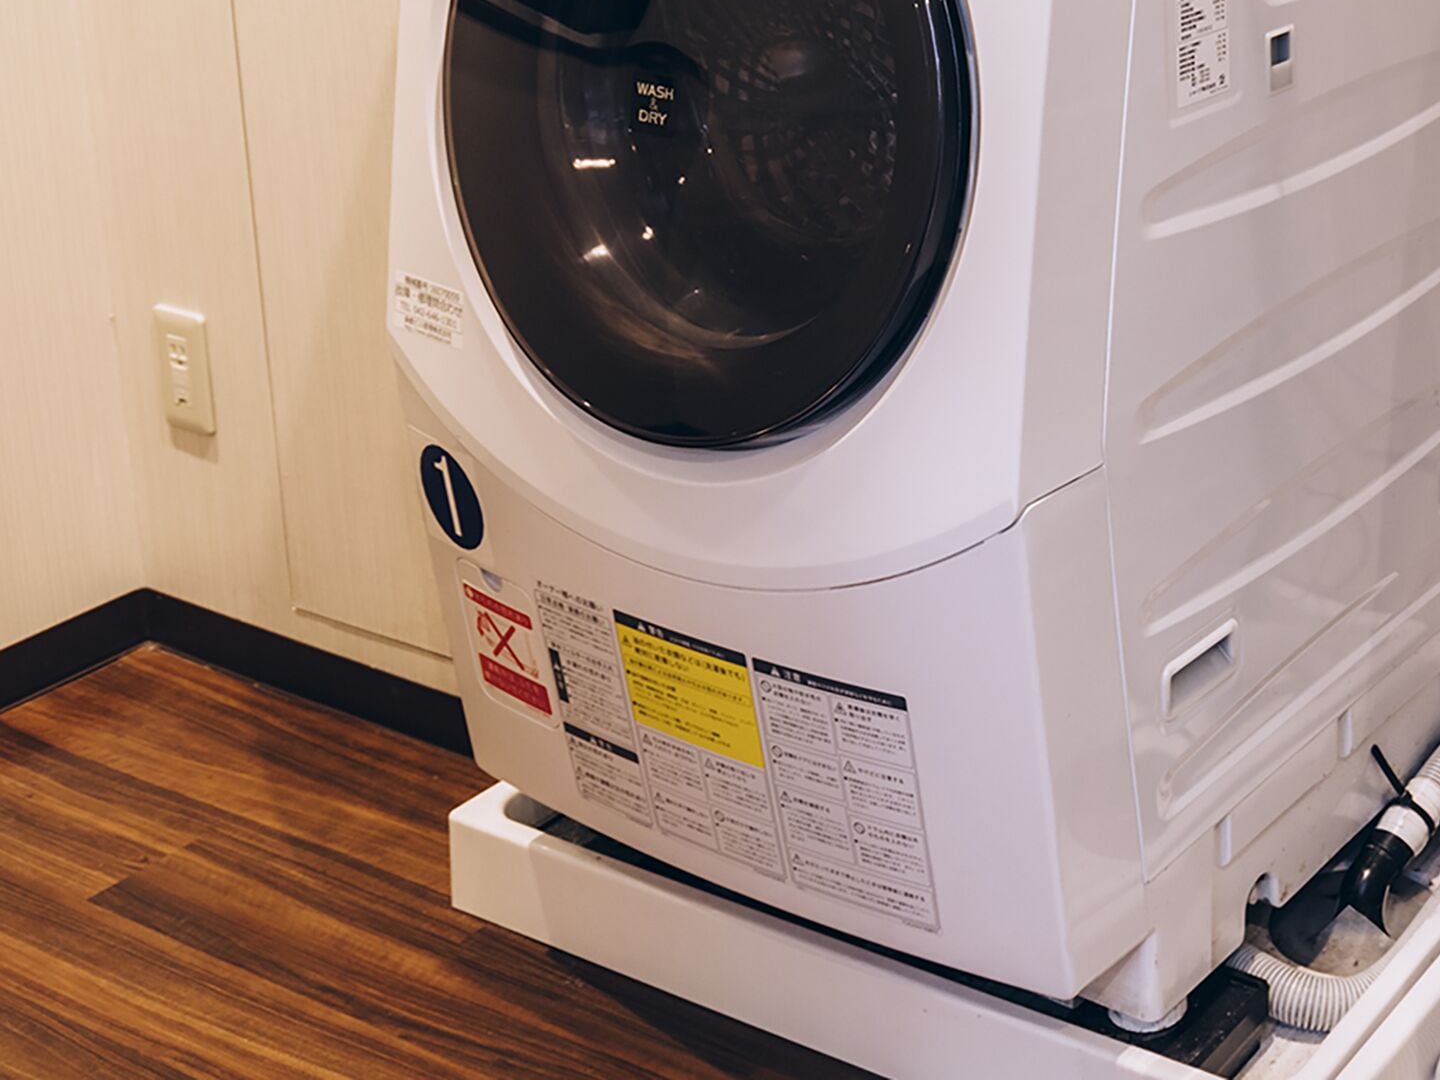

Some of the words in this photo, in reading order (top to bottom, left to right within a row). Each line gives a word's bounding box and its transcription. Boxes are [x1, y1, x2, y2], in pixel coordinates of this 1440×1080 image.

[636, 81, 675, 100] WASH
[638, 108, 668, 126] DRY
[433, 455, 463, 537] 1
